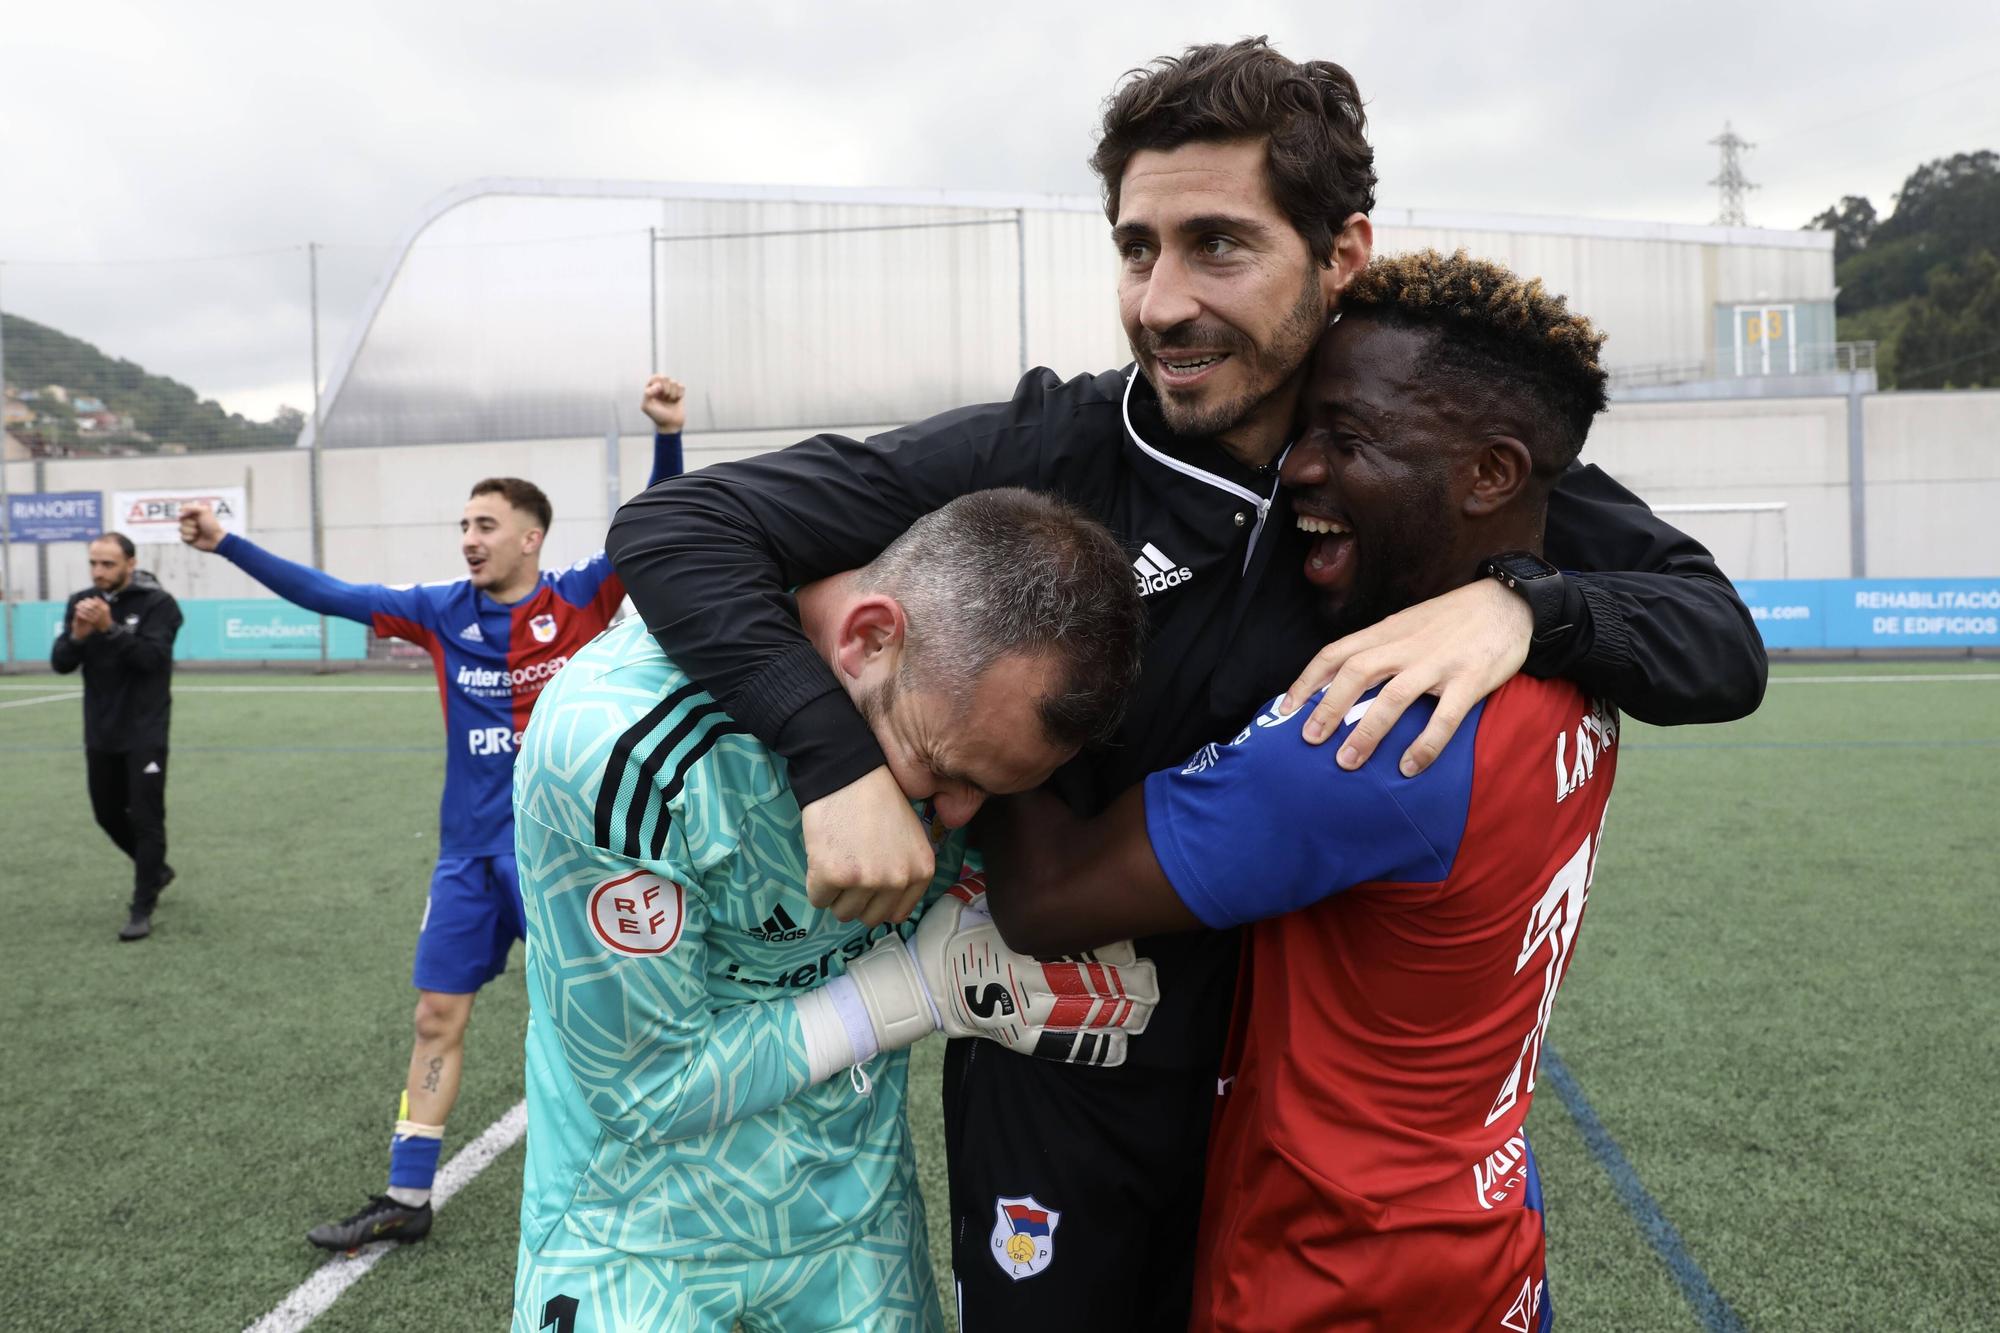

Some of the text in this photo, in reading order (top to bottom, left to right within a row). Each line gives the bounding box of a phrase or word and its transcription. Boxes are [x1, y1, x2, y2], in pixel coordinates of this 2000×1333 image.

[129, 500, 232, 519] APEA
[1136, 567, 1193, 596] didas
[1872, 616, 1997, 634] DE EDIFICIOS
[469, 726, 513, 756] PJR
